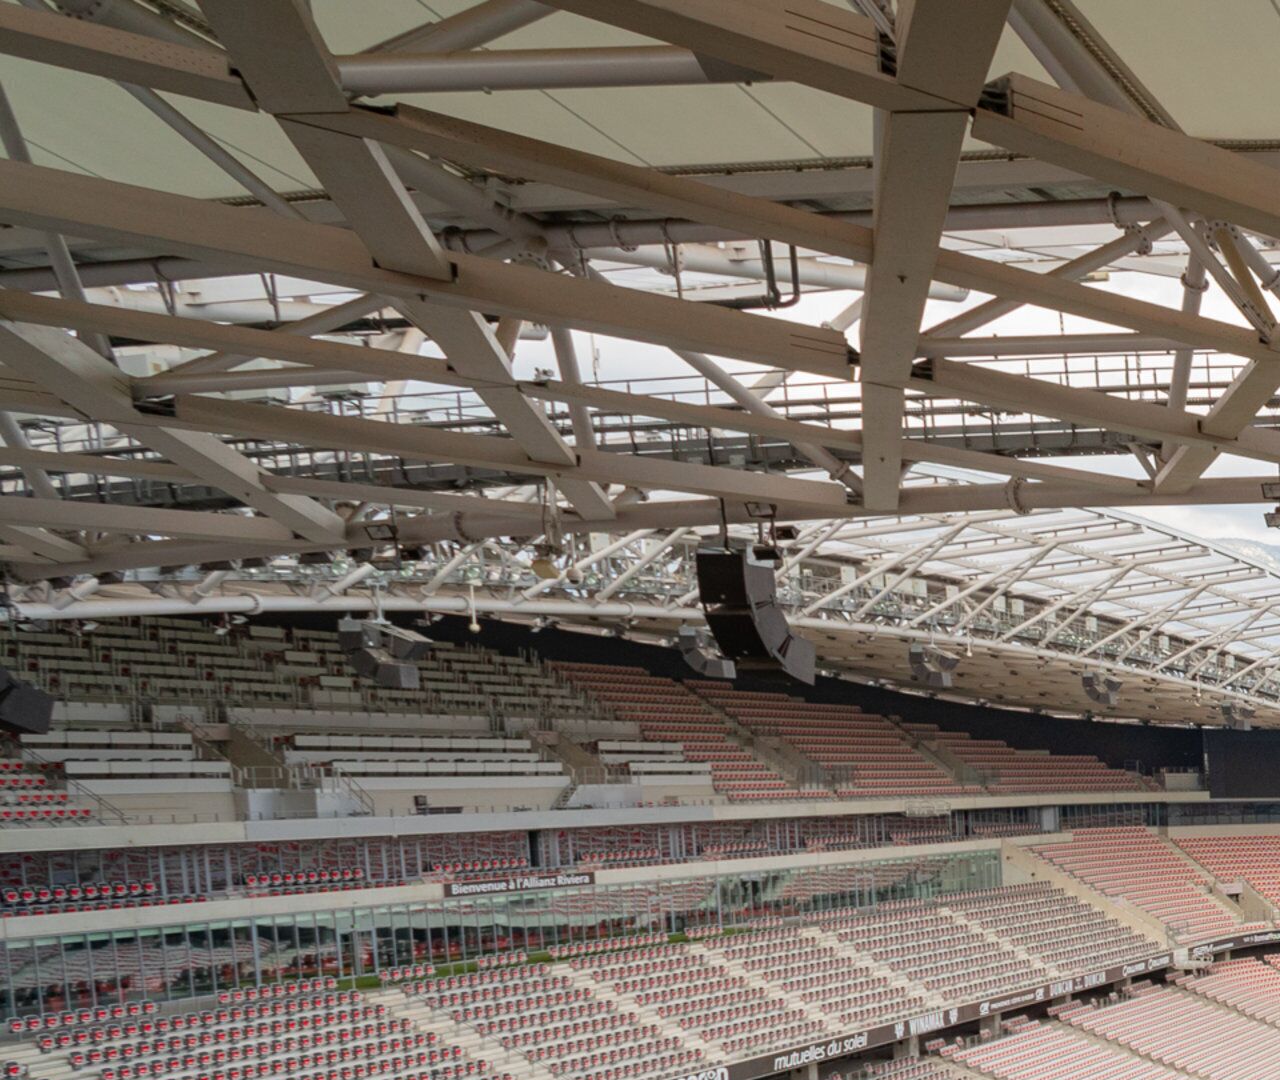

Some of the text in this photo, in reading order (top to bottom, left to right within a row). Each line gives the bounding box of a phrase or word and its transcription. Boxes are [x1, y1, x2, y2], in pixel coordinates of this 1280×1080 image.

[451, 883, 508, 895] Bienvenue
[557, 875, 590, 885] Riviera
[774, 1031, 869, 1072] mutuelles du soleil
